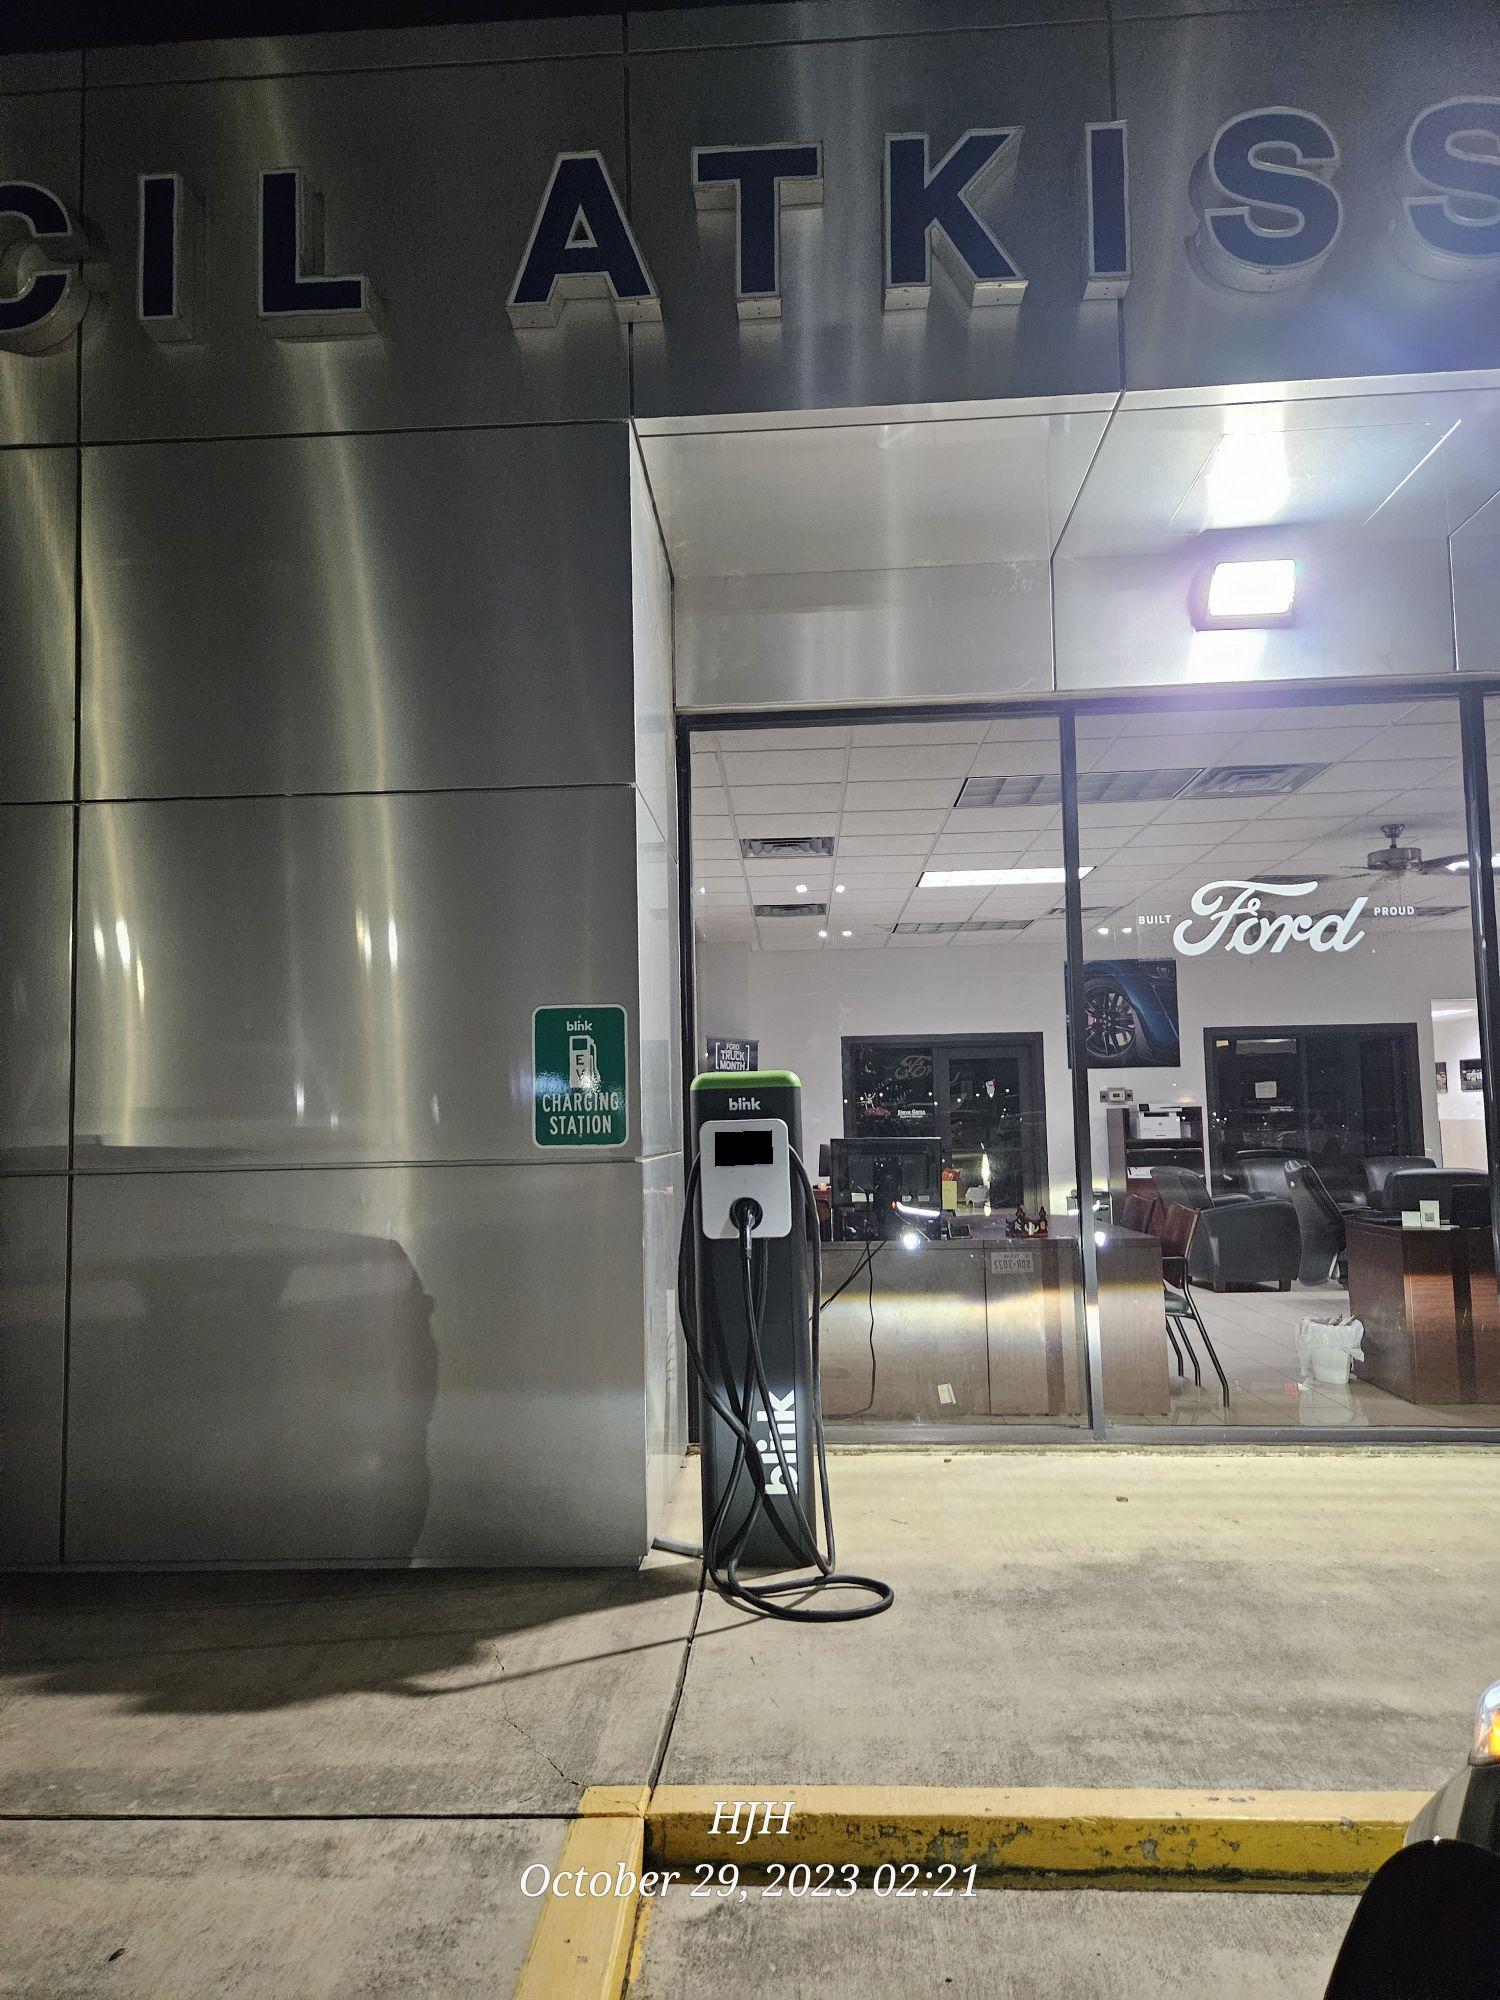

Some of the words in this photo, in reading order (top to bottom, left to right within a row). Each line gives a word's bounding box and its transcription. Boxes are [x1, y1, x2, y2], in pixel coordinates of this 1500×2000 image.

[505, 96, 1500, 306] ATKISS
[1138, 914, 1172, 925] BUILT
[1173, 880, 1369, 956] Ford
[1373, 906, 1415, 916] PROUD
[566, 1021, 593, 1031] blink
[719, 1060, 746, 1070] MONTH
[720, 1050, 745, 1061] TRUCK
[542, 1092, 619, 1112] CHARGING
[728, 1097, 761, 1111] blink
[550, 1115, 612, 1135] STATION
[756, 1389, 799, 1495] blink
